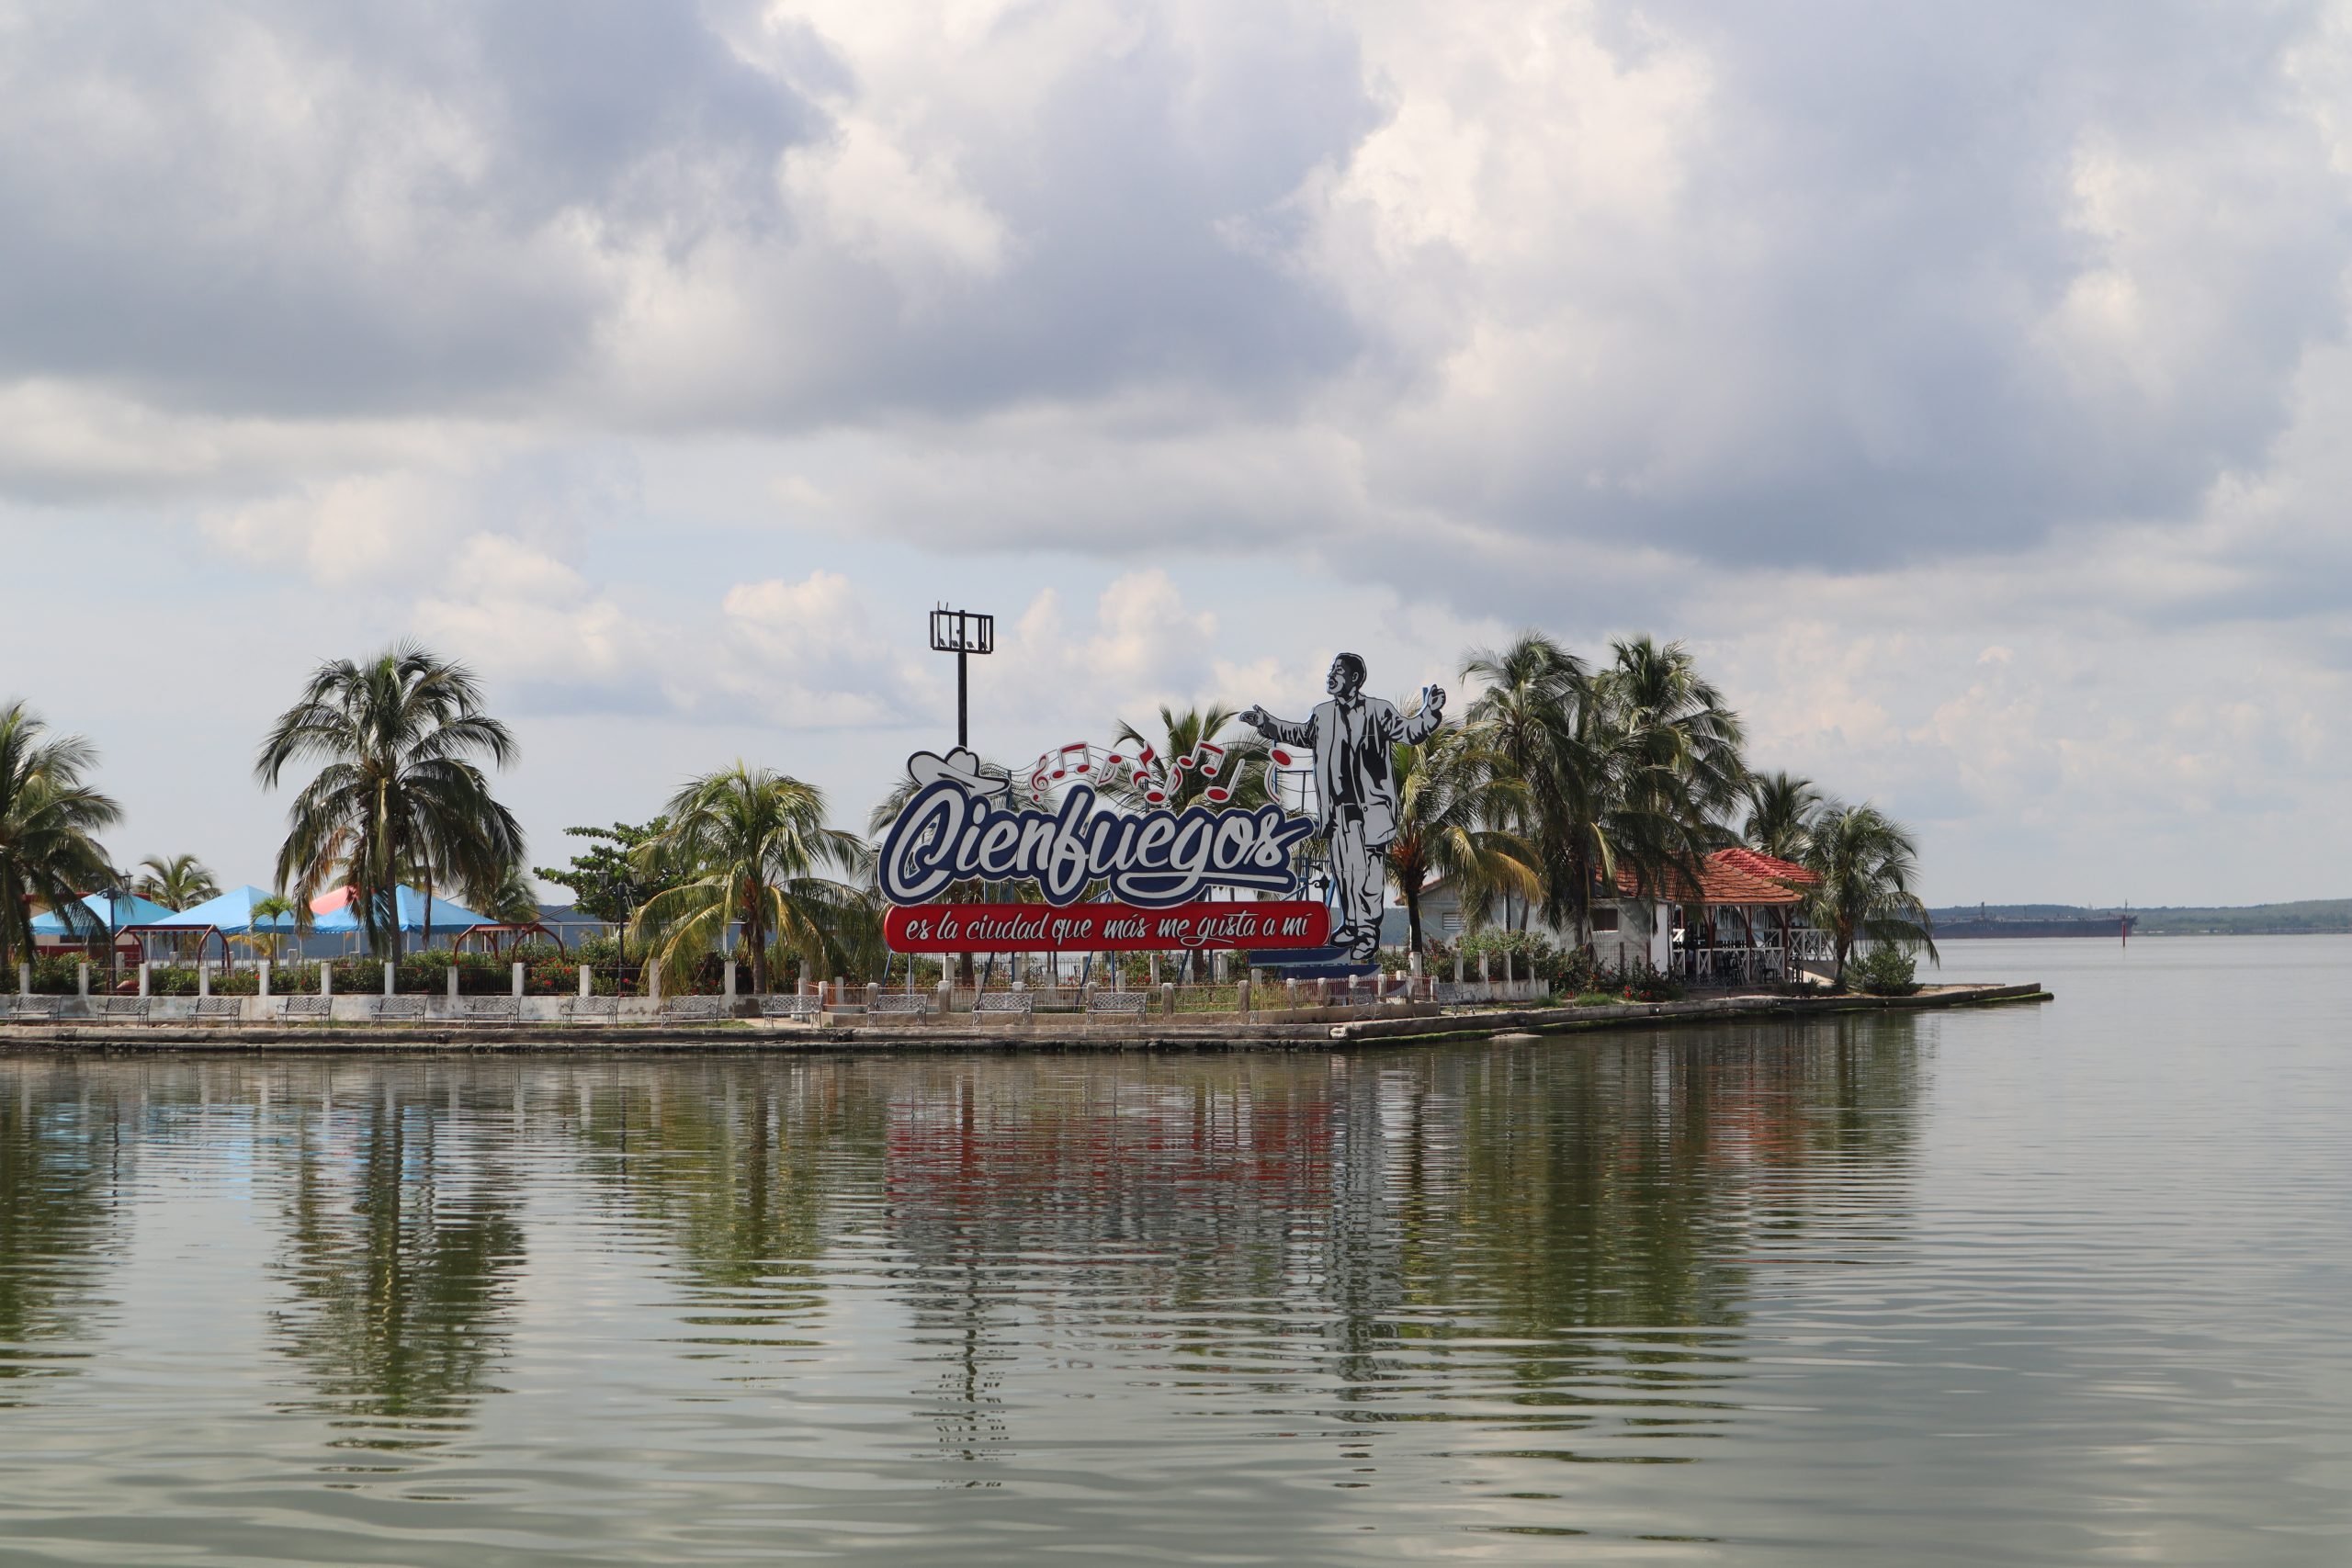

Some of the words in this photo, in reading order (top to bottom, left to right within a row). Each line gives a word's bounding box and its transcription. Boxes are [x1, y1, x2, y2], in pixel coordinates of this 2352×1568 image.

[888, 787, 1309, 898] Cienfuegos
[905, 919, 934, 941] es
[936, 910, 958, 940] la
[966, 912, 1050, 940] ciudad
[1051, 918, 1092, 945] que
[1102, 913, 1152, 939] más
[1157, 917, 1191, 938] me
[1180, 909, 1260, 947] gusta
[1262, 917, 1276, 937] a
[1281, 913, 1313, 937] mí
